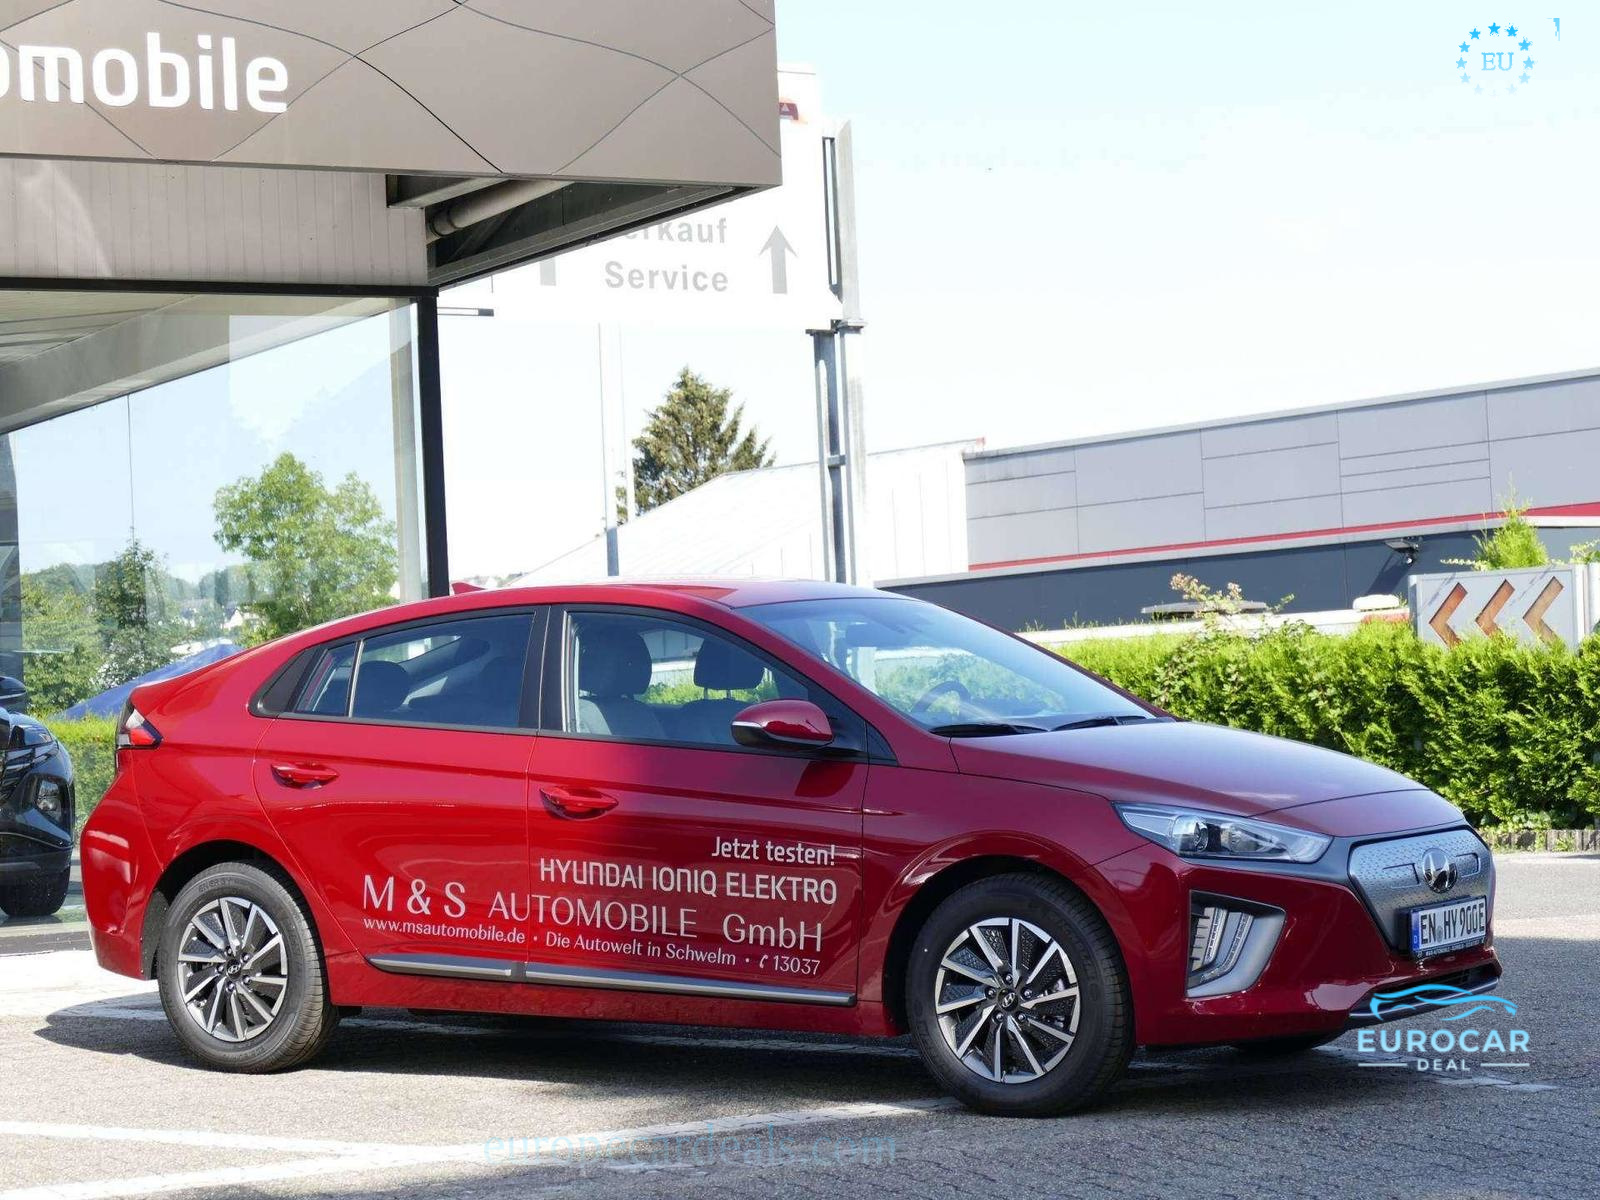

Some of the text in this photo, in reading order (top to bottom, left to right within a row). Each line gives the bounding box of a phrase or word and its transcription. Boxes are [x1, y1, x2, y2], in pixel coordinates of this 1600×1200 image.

[0, 32, 289, 114] mobile
[624, 217, 728, 243] rkauf
[604, 260, 729, 292] Service
[711, 836, 836, 866] Jetzt testen!
[540, 857, 837, 905] HYUNDAI IONIQ ELEKTRO
[363, 874, 822, 953] M & S AUTOMOBILE GmbH
[1420, 912, 1437, 945] EN
[363, 917, 821, 976] www.msautomobile.de Die Autowelt in Schwelm 13037
